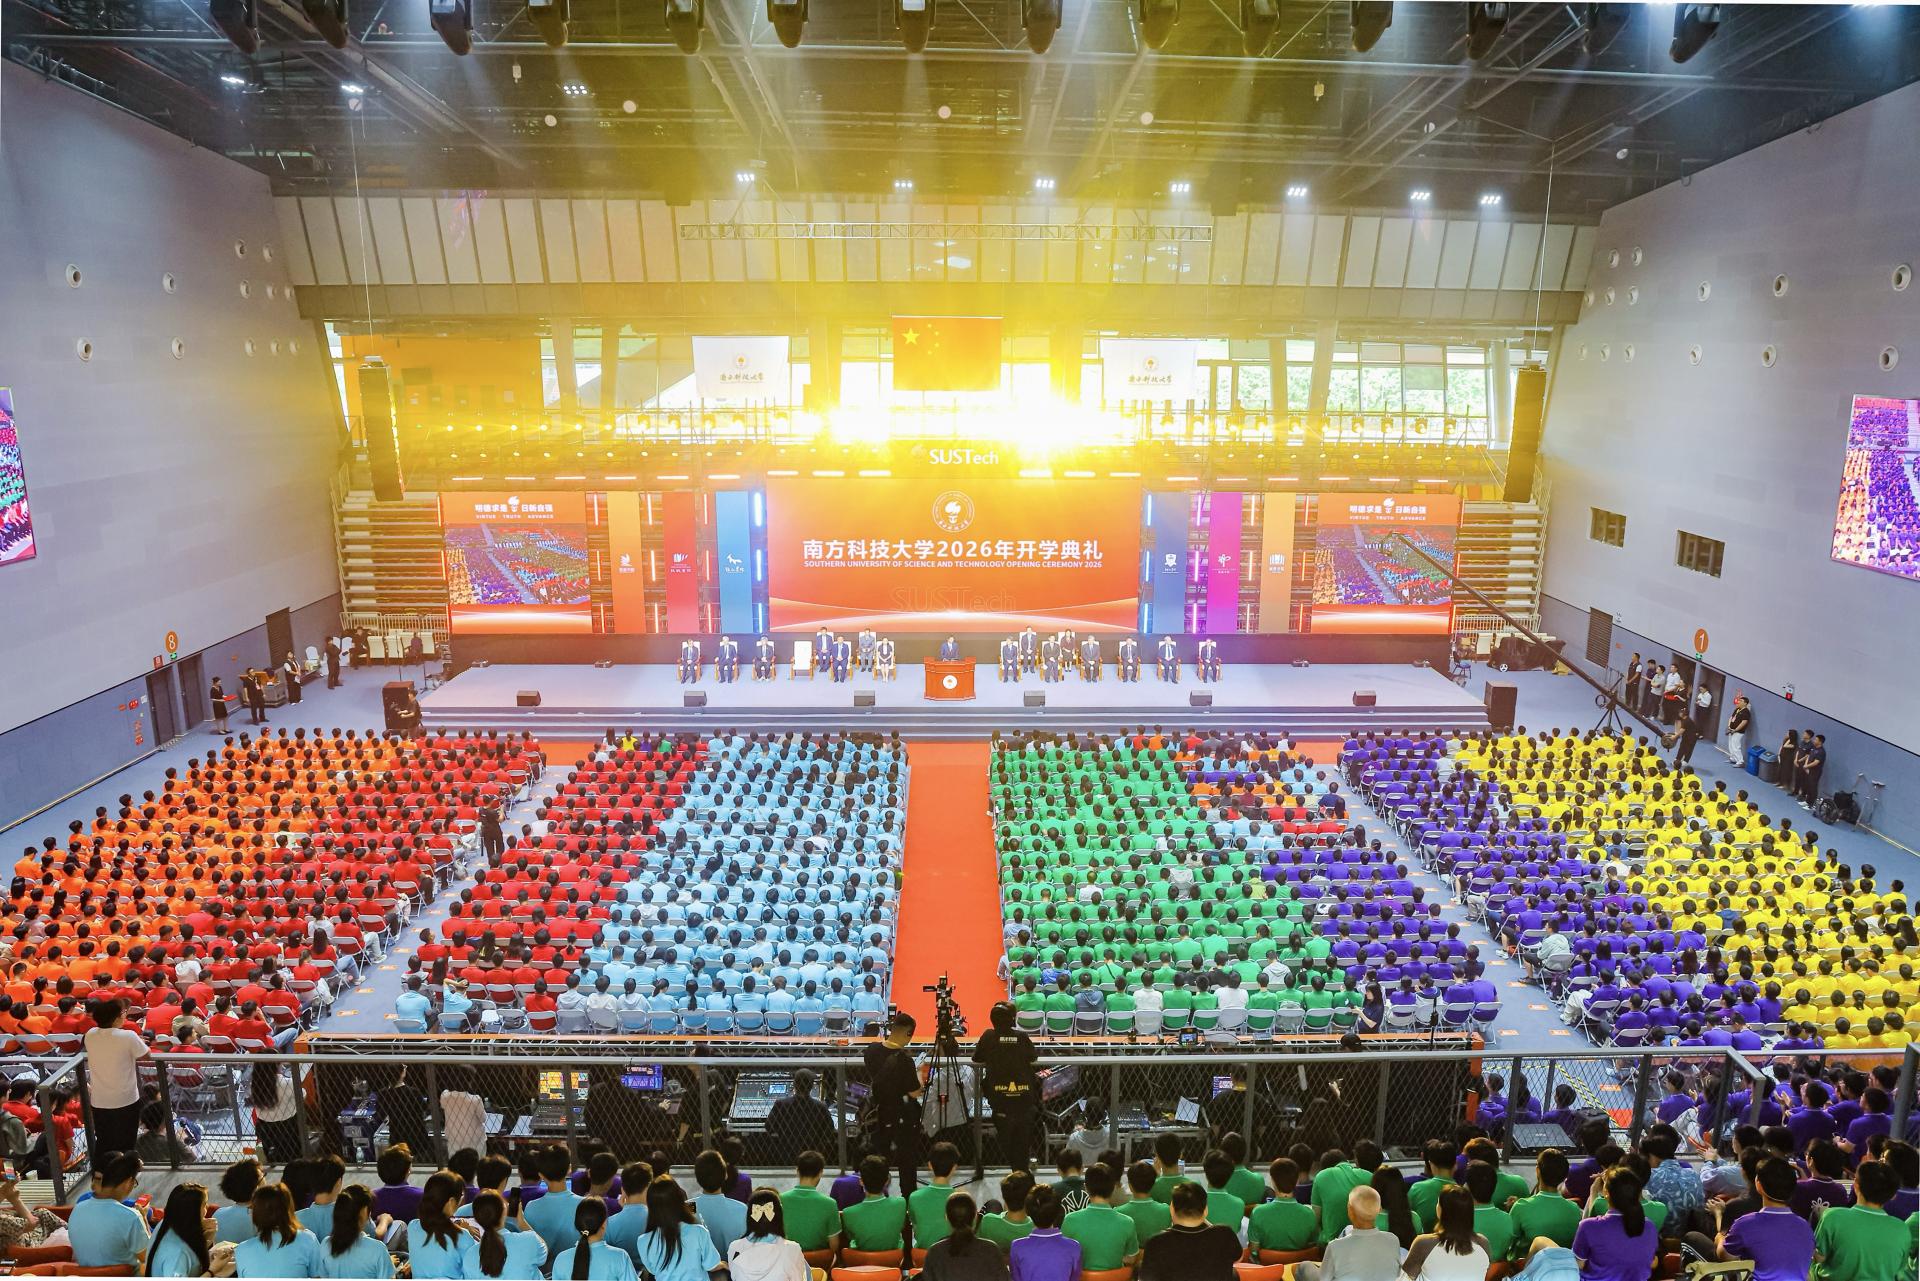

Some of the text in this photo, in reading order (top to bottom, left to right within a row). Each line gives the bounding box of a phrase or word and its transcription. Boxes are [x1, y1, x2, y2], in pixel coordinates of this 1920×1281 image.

[929, 449, 999, 465] SUSTech
[802, 539, 1104, 560] 南方科技大学2026年开学典礼
[803, 560, 1103, 568] SOUTHERN UNIVERSITY OF SCIENCE AND TECHNOLOGY OPENING CEREMONY 2026
[168, 634, 175, 650] 8
[1699, 633, 1705, 650] 1
